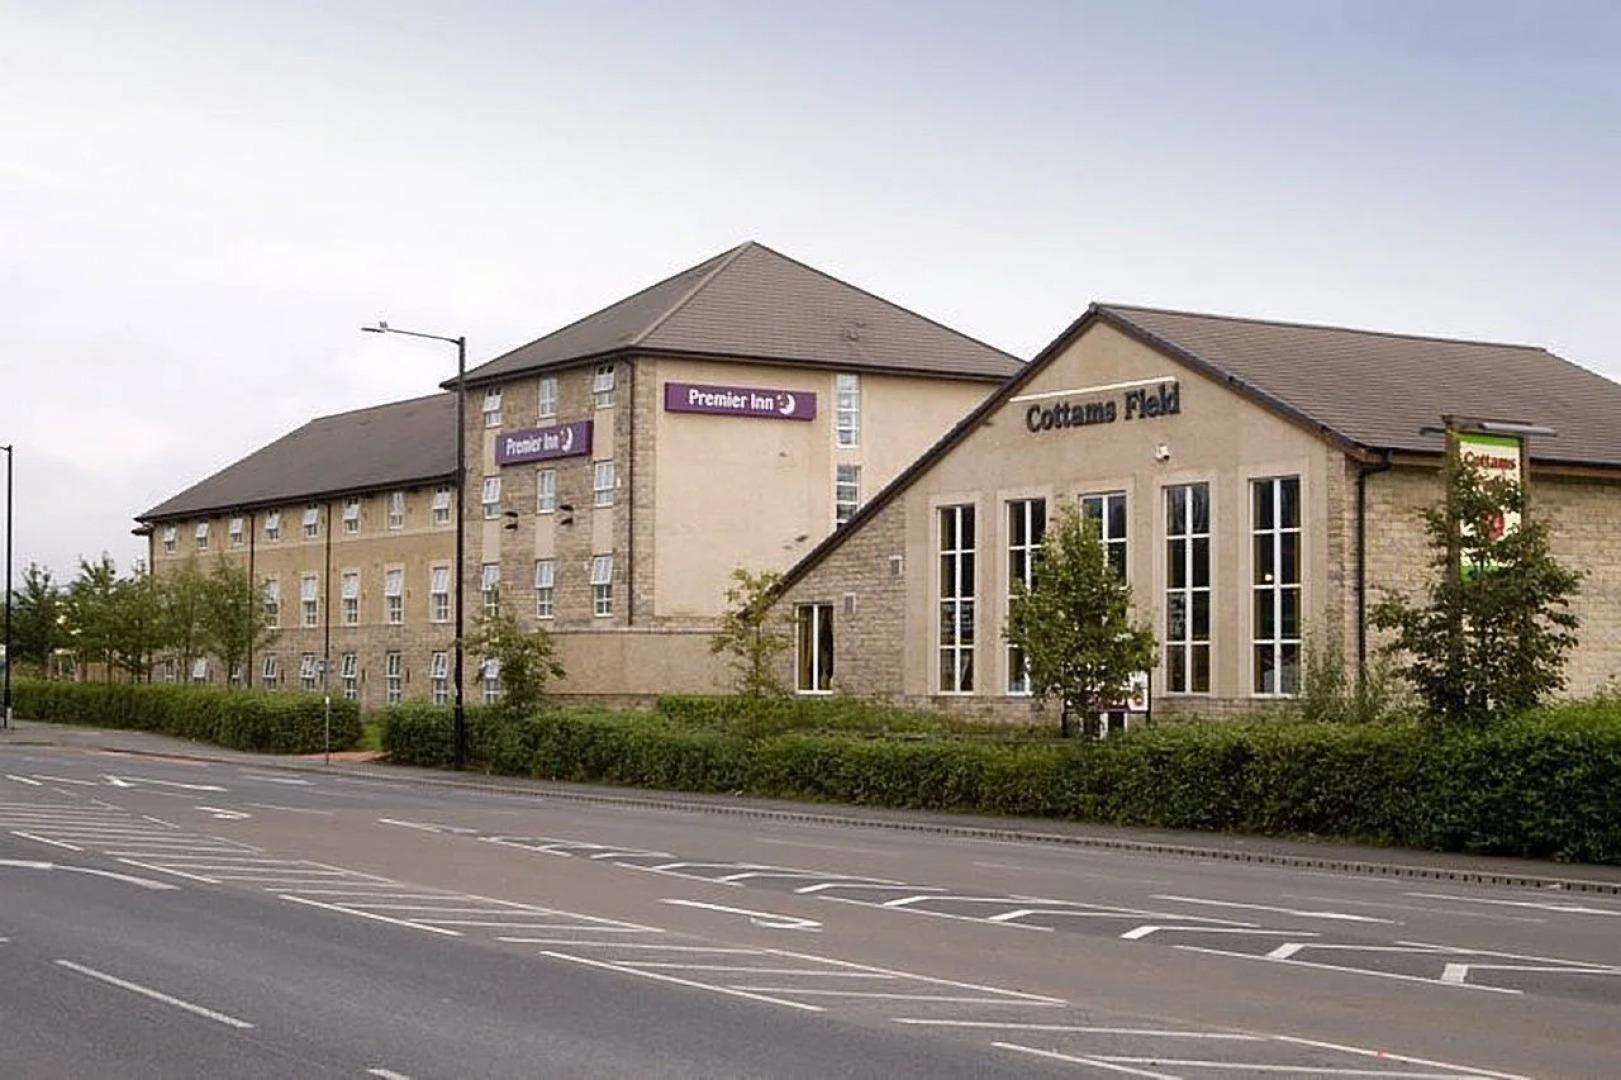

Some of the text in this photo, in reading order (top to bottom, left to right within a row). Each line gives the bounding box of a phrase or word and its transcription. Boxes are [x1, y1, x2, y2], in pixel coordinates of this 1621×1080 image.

[688, 389, 774, 411] Premier Inn
[1026, 382, 1180, 432] Cottams Field
[506, 432, 559, 456] Premier Inn
